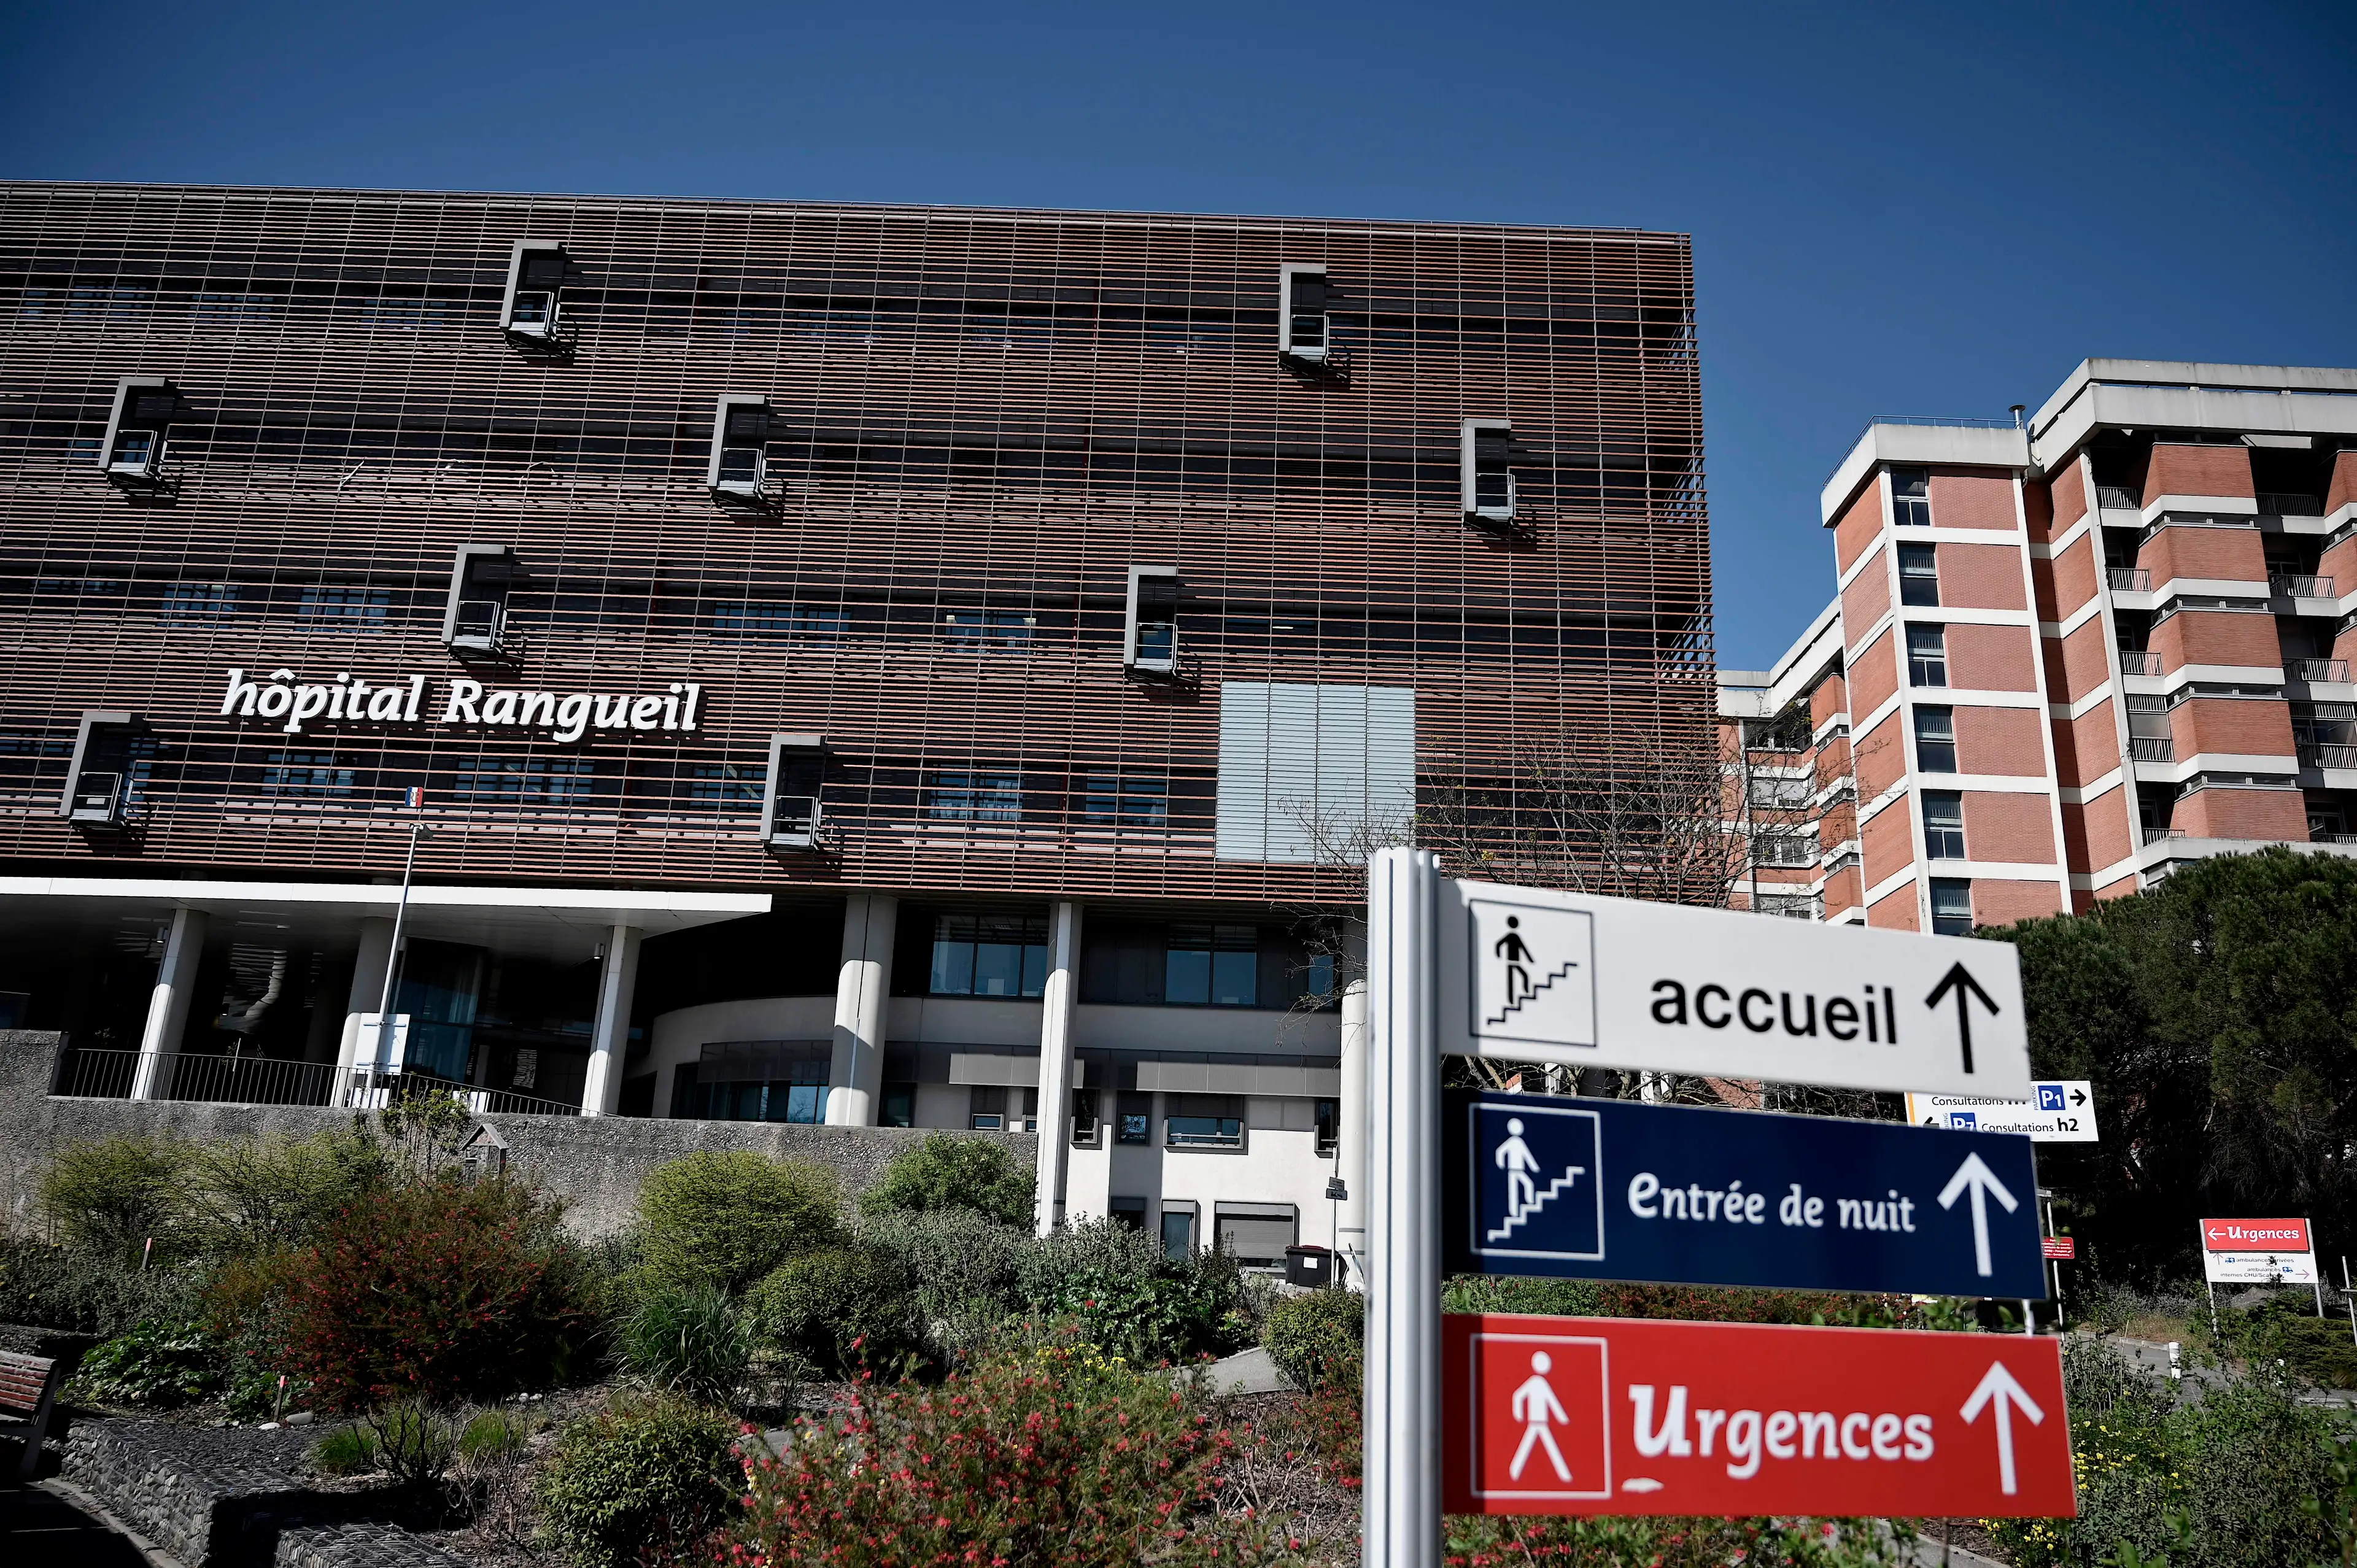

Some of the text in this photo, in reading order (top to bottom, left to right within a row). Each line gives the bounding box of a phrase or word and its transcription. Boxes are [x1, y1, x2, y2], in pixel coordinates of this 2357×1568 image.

[220, 668, 701, 743] hôpital Rangueil
[1649, 978, 1898, 1045] accueil
[1932, 1095, 2004, 1105] Consultations
[2041, 1090, 2062, 1108] P1
[1982, 1117, 2080, 1133] Consultations h2
[1779, 1183, 1824, 1227] de
[1837, 1189, 1916, 1232] nuit
[2227, 1226, 2299, 1243] Urgences
